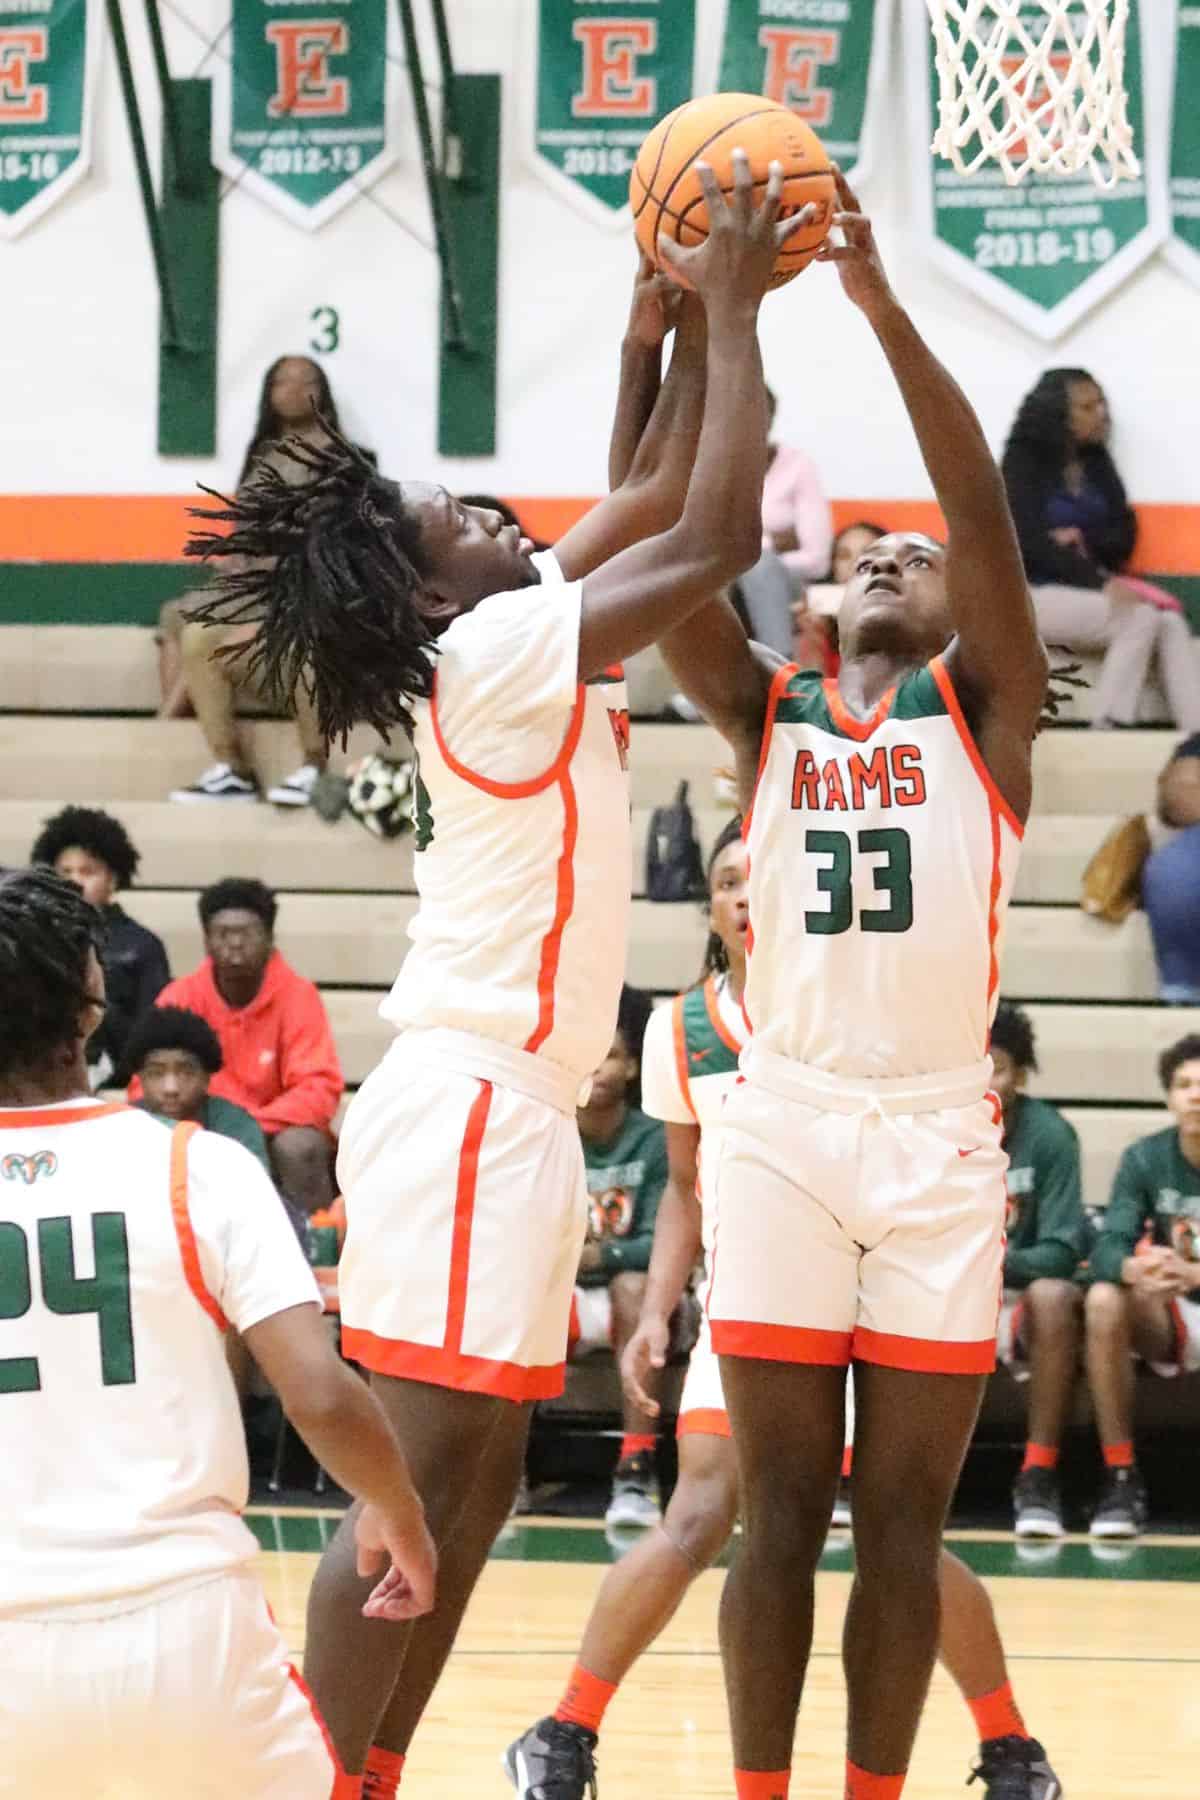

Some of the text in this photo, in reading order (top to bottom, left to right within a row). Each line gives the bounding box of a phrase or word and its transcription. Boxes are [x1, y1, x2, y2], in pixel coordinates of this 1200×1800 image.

[265, 20, 349, 117] E
[572, 19, 656, 117] E
[0, 152, 59, 181] 5-16
[974, 228, 1115, 267] 2018-19
[309, 306, 339, 353] 3
[791, 744, 927, 811] RAMS
[804, 827, 914, 935] 33
